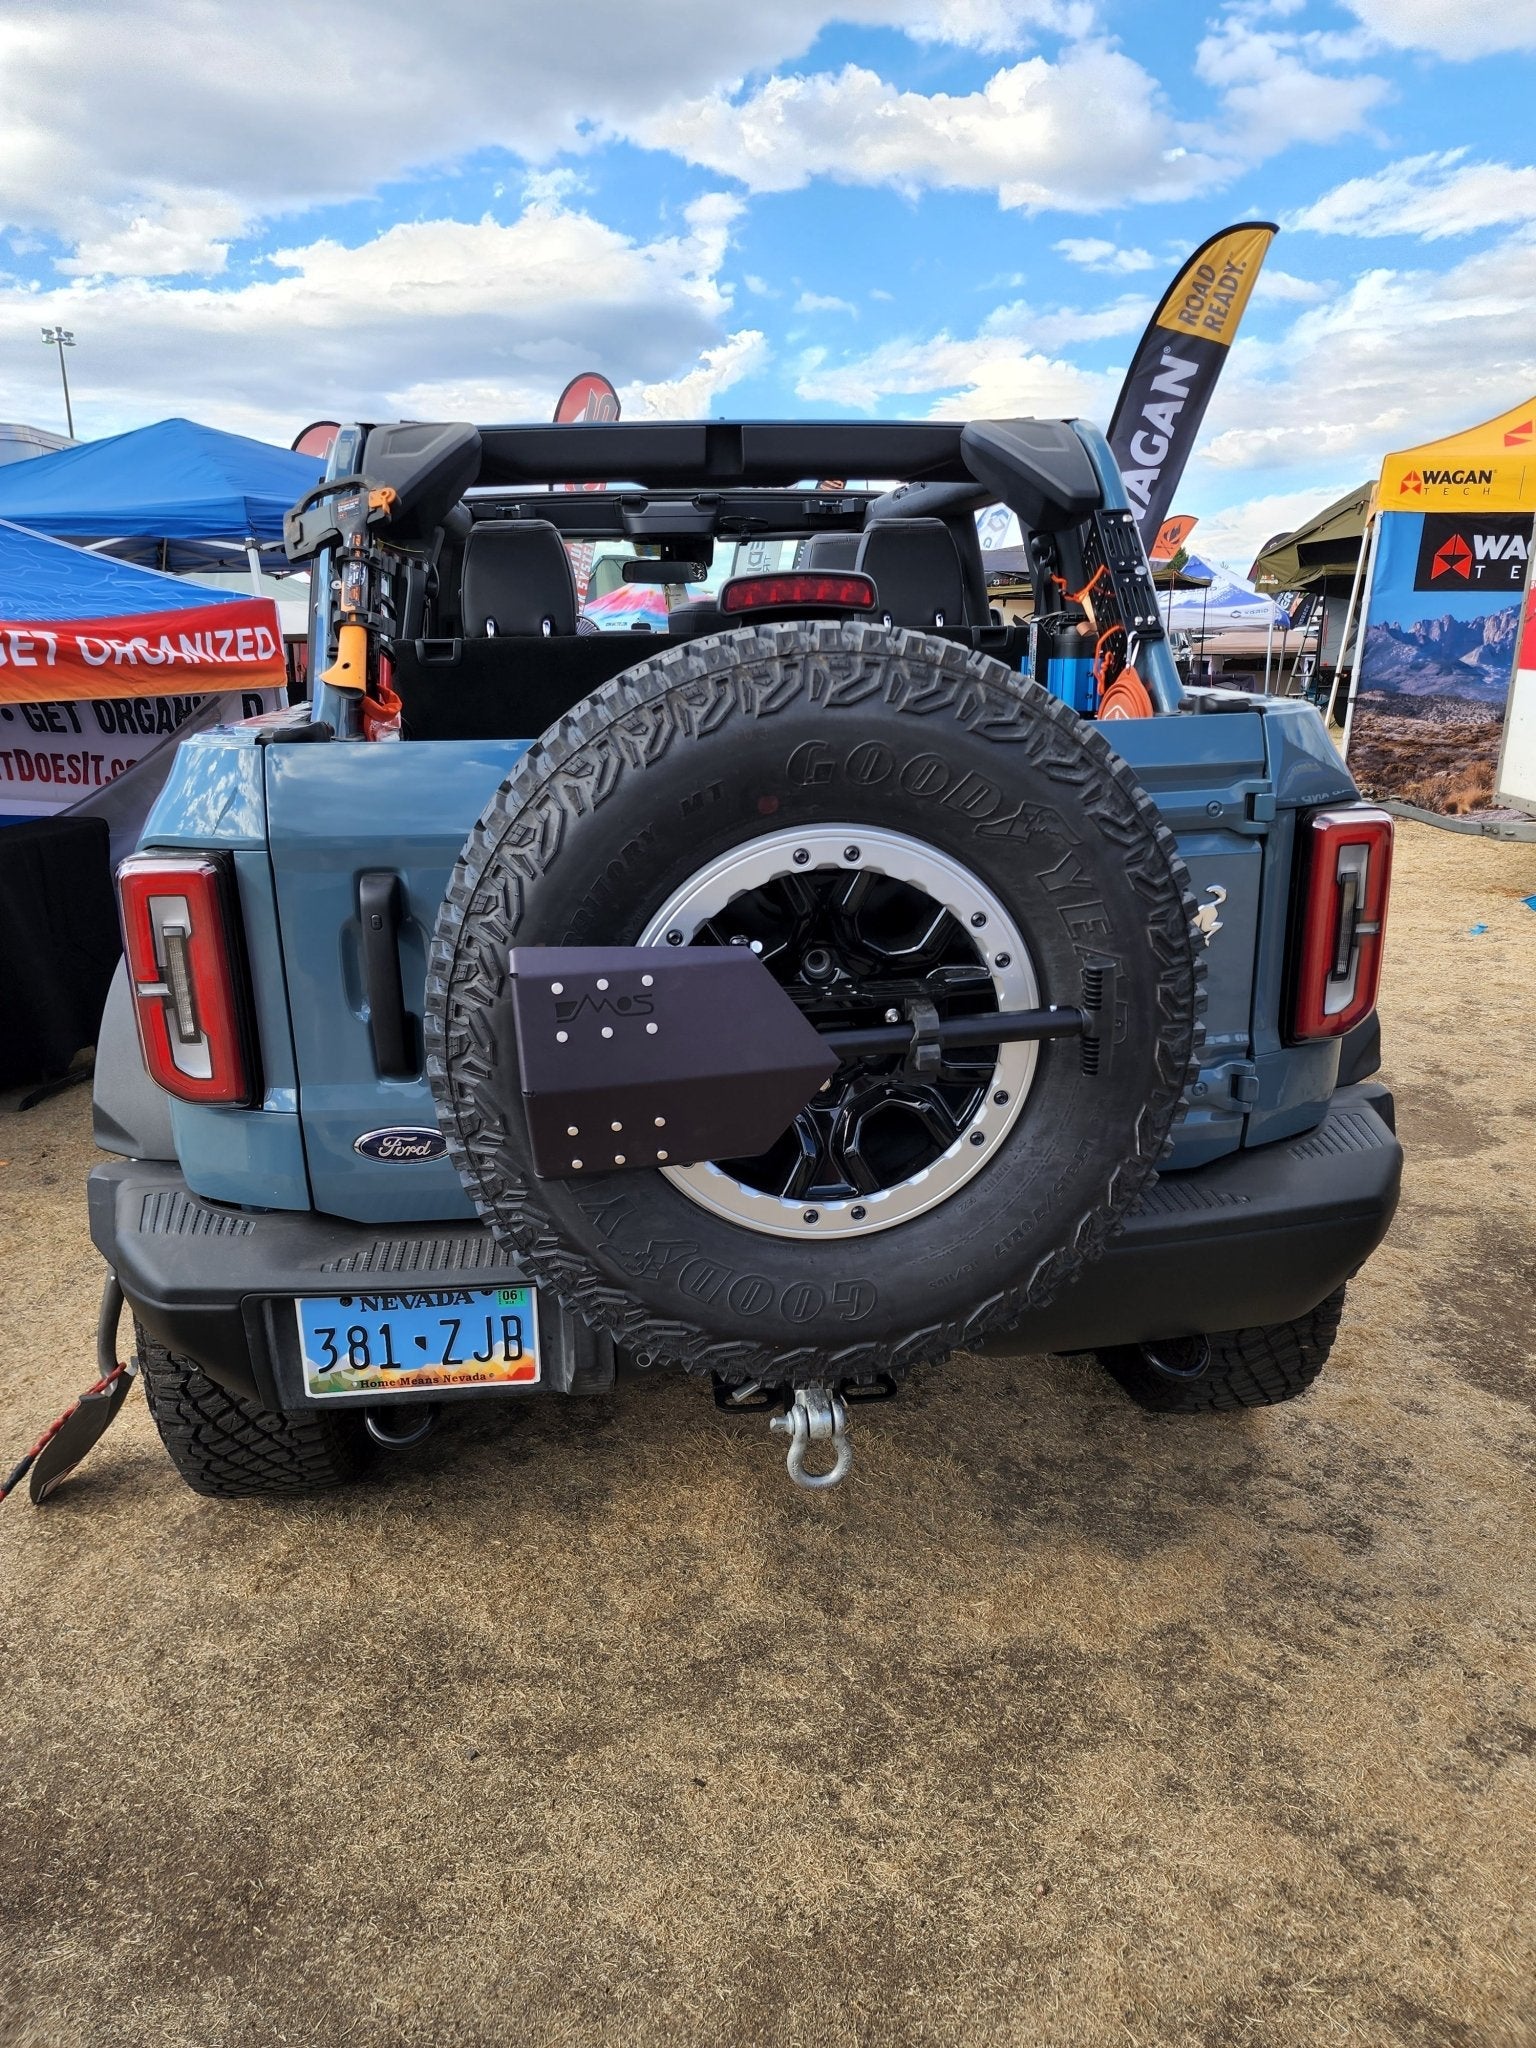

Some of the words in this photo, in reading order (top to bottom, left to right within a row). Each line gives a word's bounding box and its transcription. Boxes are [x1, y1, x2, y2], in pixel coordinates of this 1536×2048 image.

[1178, 264, 1216, 327] ROAD
[1203, 259, 1247, 333] READY.
[1422, 470, 1493, 485] WAGAN
[75, 626, 276, 666] ORGANIZED
[19, 701, 82, 734] GET
[91, 693, 264, 735] ORGAND
[378, 1136, 431, 1157] Ford
[360, 1291, 474, 1312] NEVADA
[502, 1290, 517, 1300] 06
[314, 1323, 401, 1374] 381
[439, 1315, 523, 1366] ZJB
[360, 1380, 396, 1388] Home
[399, 1376, 441, 1386] Means
[443, 1373, 487, 1383] Nevada
